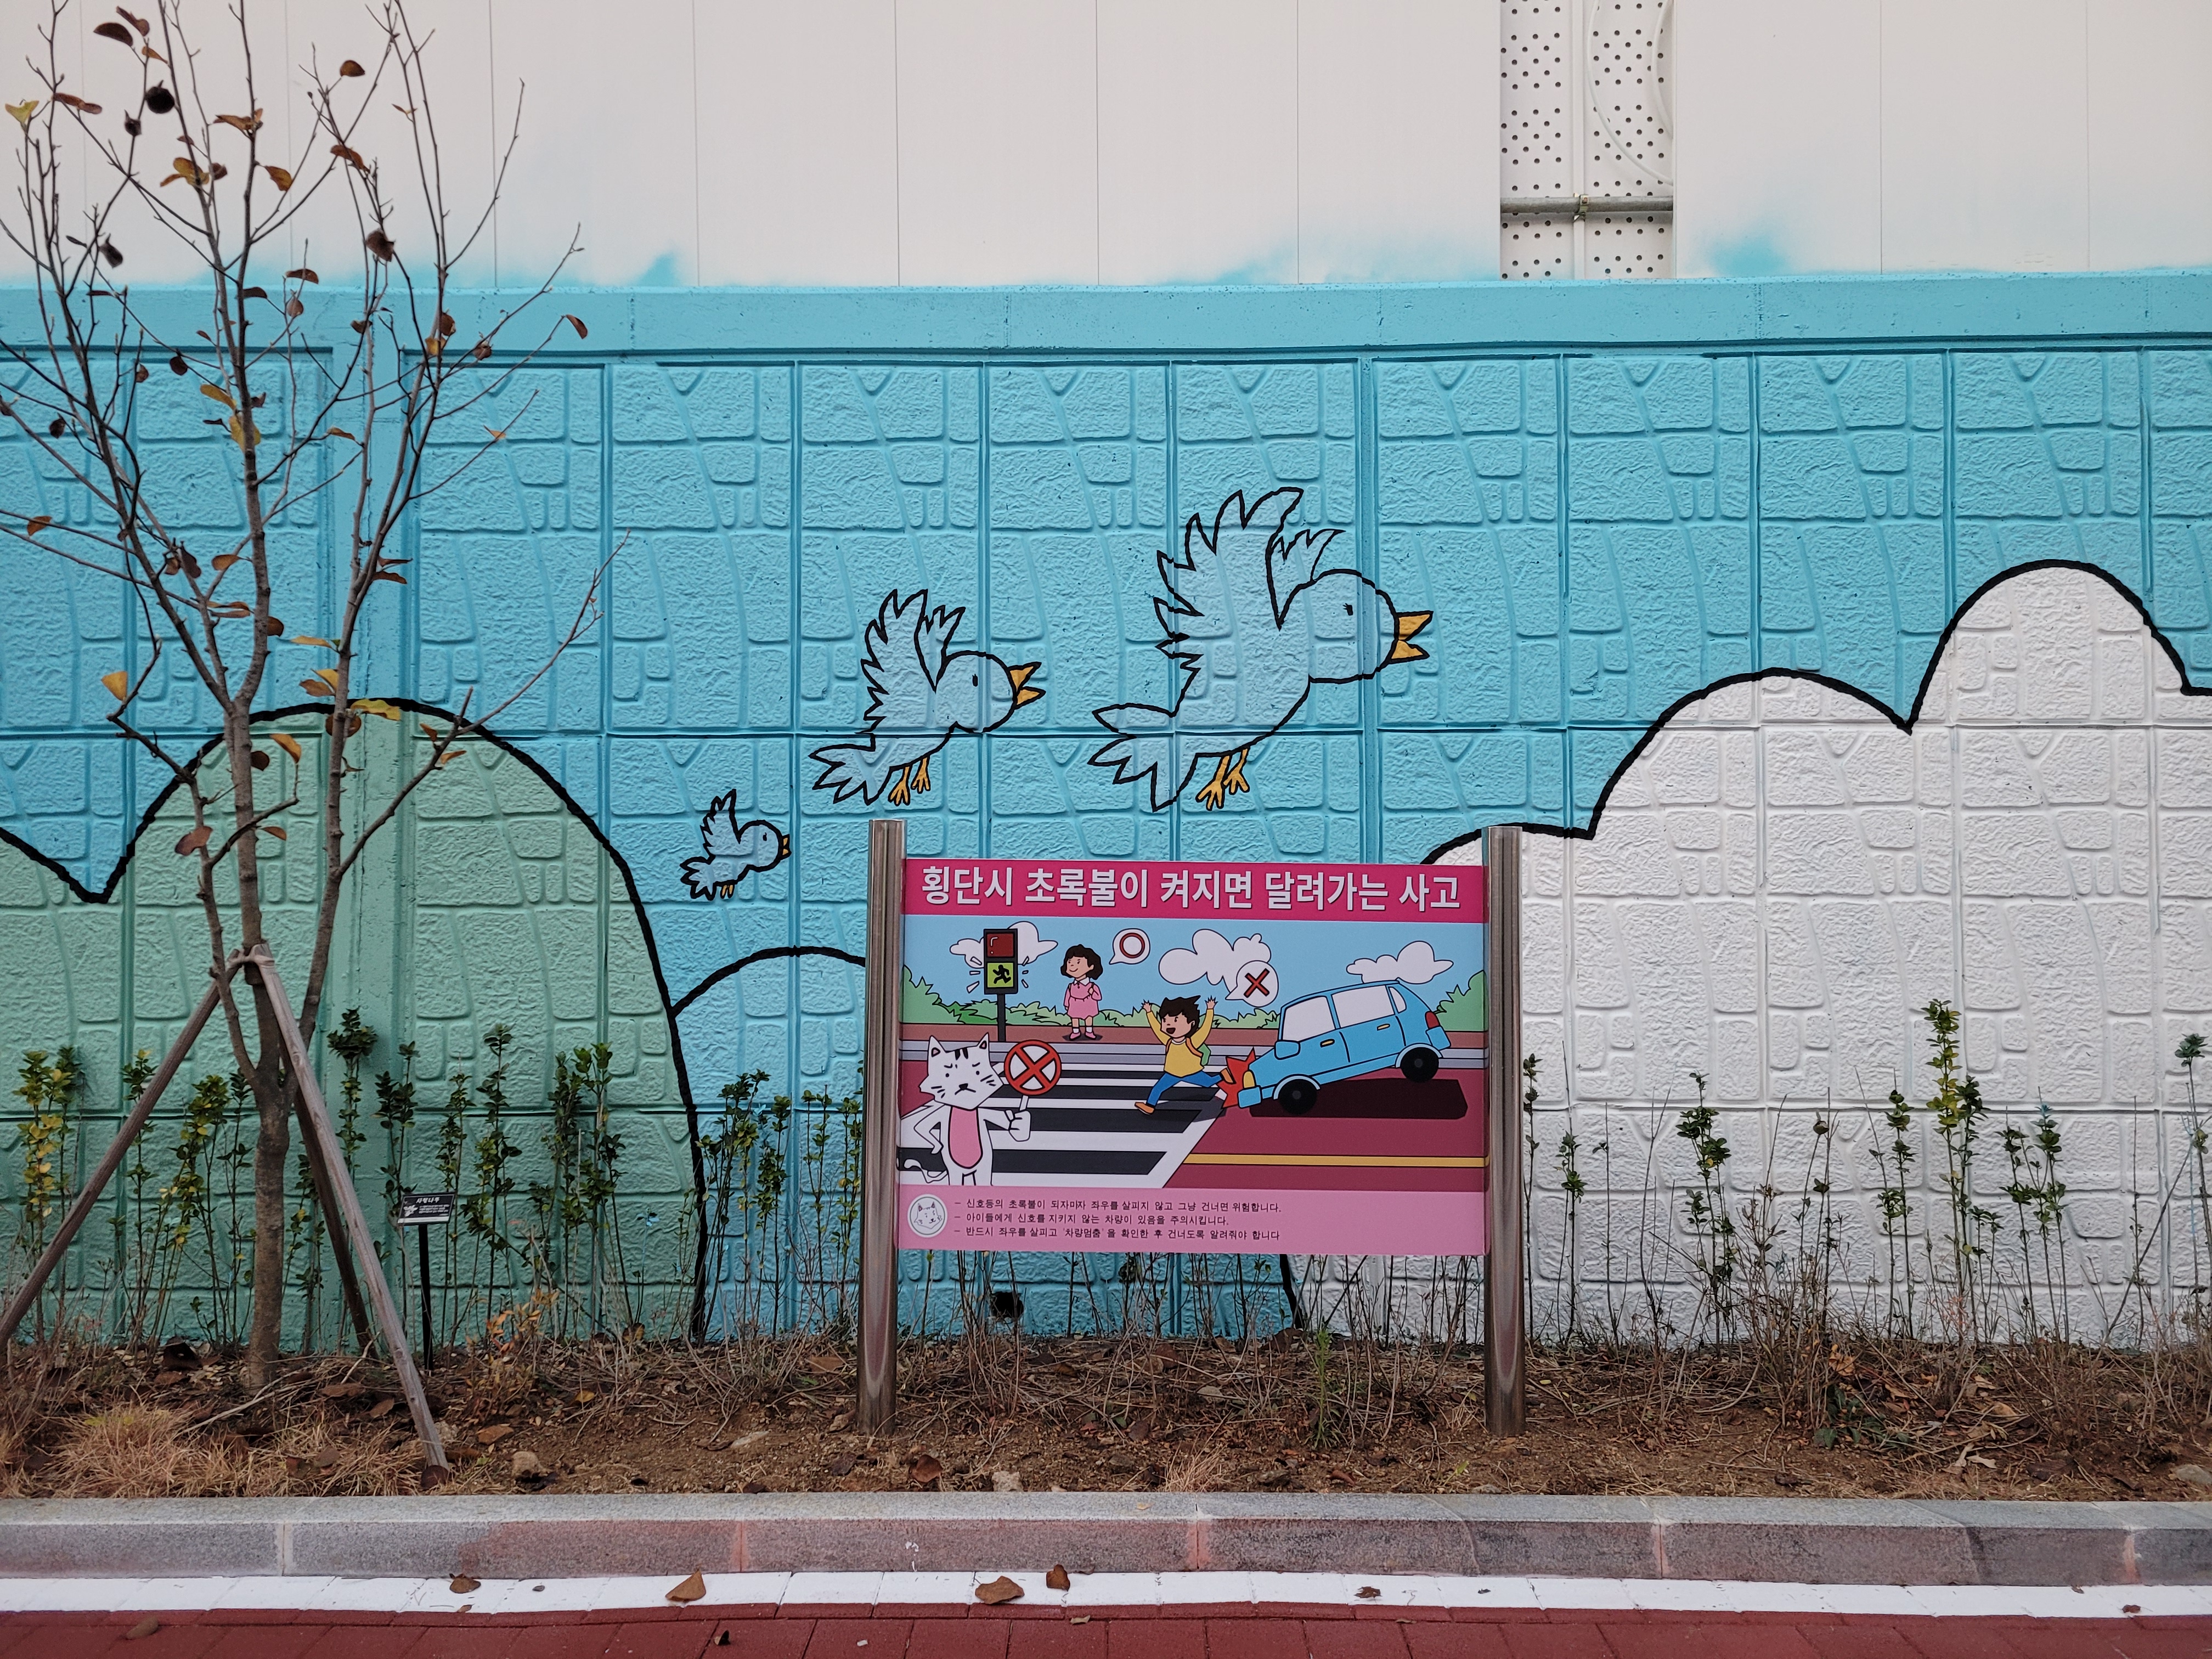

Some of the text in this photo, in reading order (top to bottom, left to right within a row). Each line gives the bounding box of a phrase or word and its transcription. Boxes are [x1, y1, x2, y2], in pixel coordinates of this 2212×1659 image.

[922, 866, 1461, 912] 횡단시 초록불이 켜지면 달려가는 사고
[967, 1199, 1281, 1212] 신호등의 초록불이 되자마자 좌우를 살피지 않고 그냥 건너면 위험합니다.
[967, 1213, 1229, 1226] 아이들에게 신호를 지키지 않는 차량이 있음을 주의시킵니다.
[966, 1227, 994, 1237] 반드시
[999, 1227, 1026, 1237] 좌우를
[1030, 1228, 1057, 1238] 살피고
[1121, 1229, 1148, 1239] 확인한
[1154, 1229, 1163, 1239] 후
[1168, 1229, 1205, 1239] 건너도록
[1210, 1230, 1247, 1240] 알려줘야
[1252, 1231, 1280, 1240] 합니다
